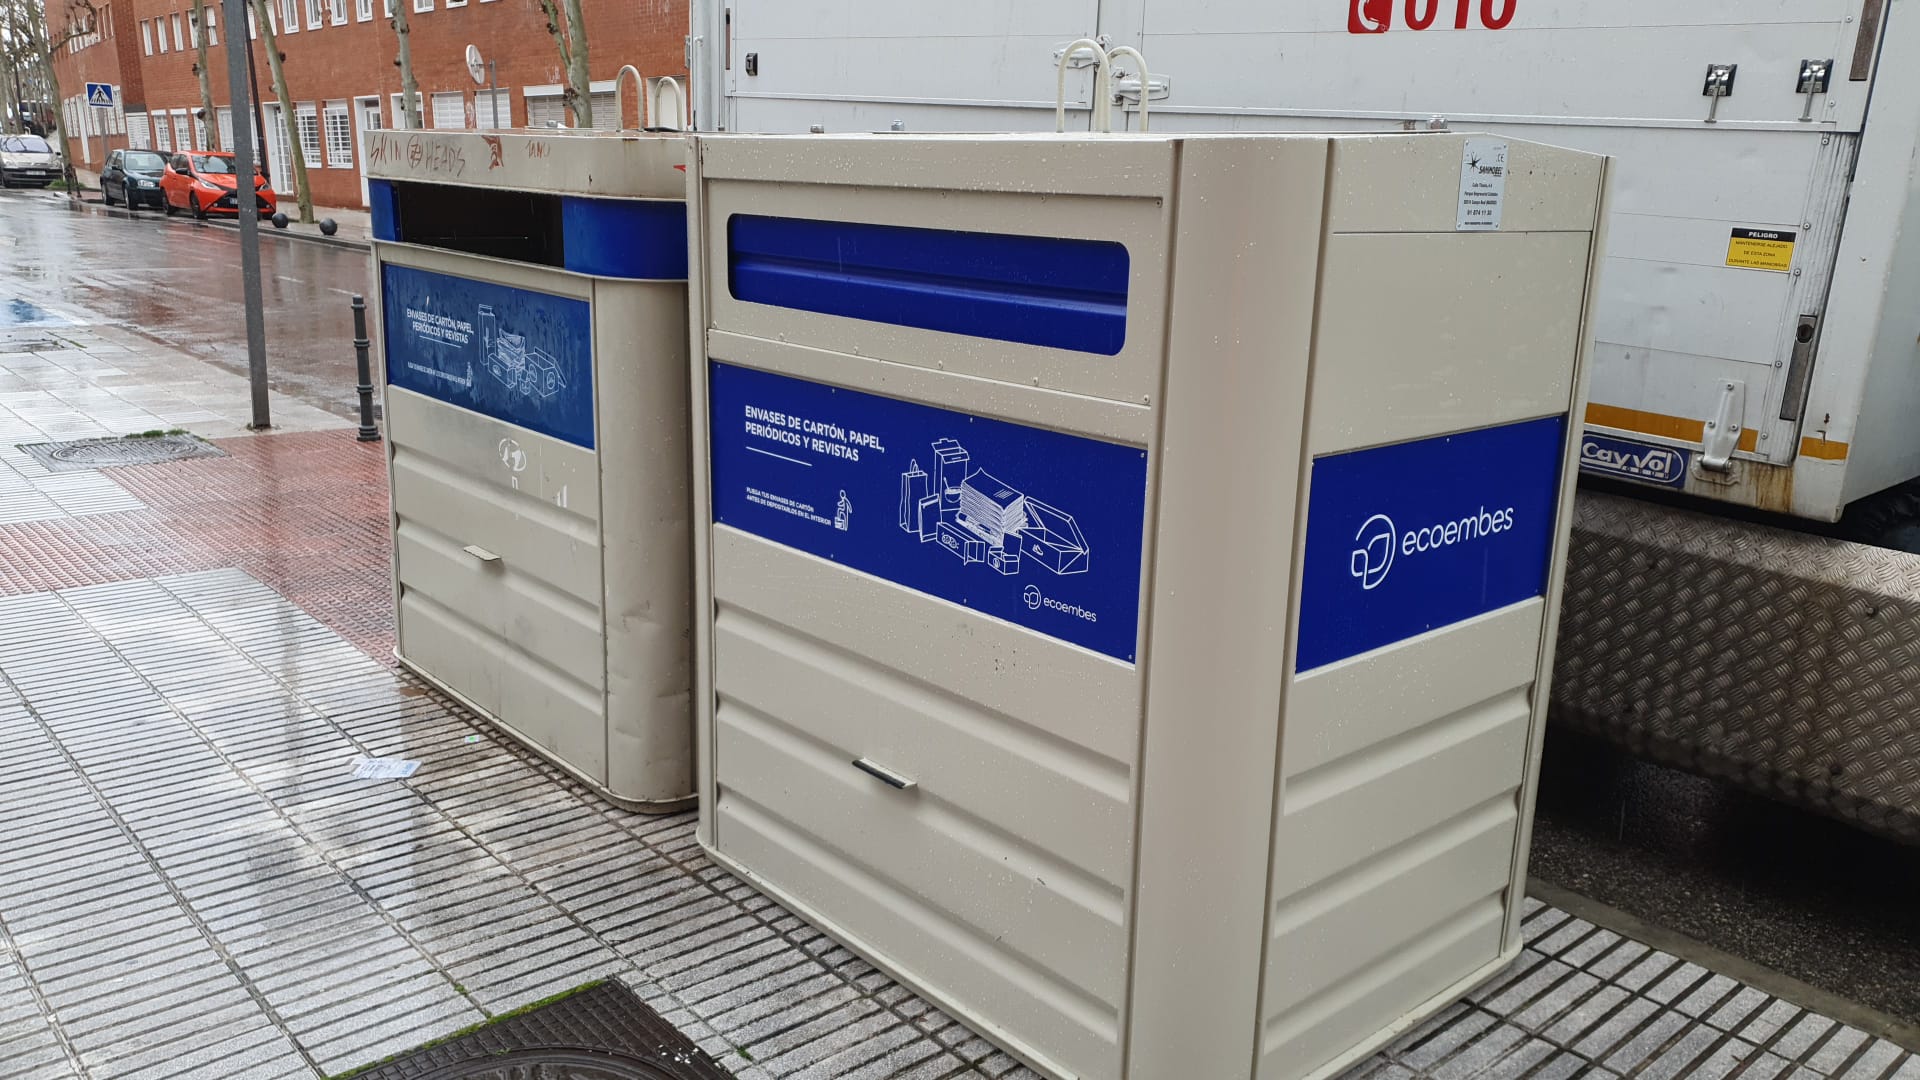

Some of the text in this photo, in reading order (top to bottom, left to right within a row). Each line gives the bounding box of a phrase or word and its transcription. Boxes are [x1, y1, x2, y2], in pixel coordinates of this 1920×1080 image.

[1748, 231, 1779, 239] PELIGRO
[406, 307, 427, 322] ENVASES
[427, 313, 435, 324] DE
[440, 328, 445, 337] Y
[445, 329, 469, 344] REVISTAS
[745, 405, 885, 454] ENVASES DE CARTÓN, PAPEL,
[745, 421, 860, 462] PERIÓDICOS Y REVISTAS
[1402, 505, 1514, 555] ecoembes
[1043, 597, 1097, 622] ecoembes
